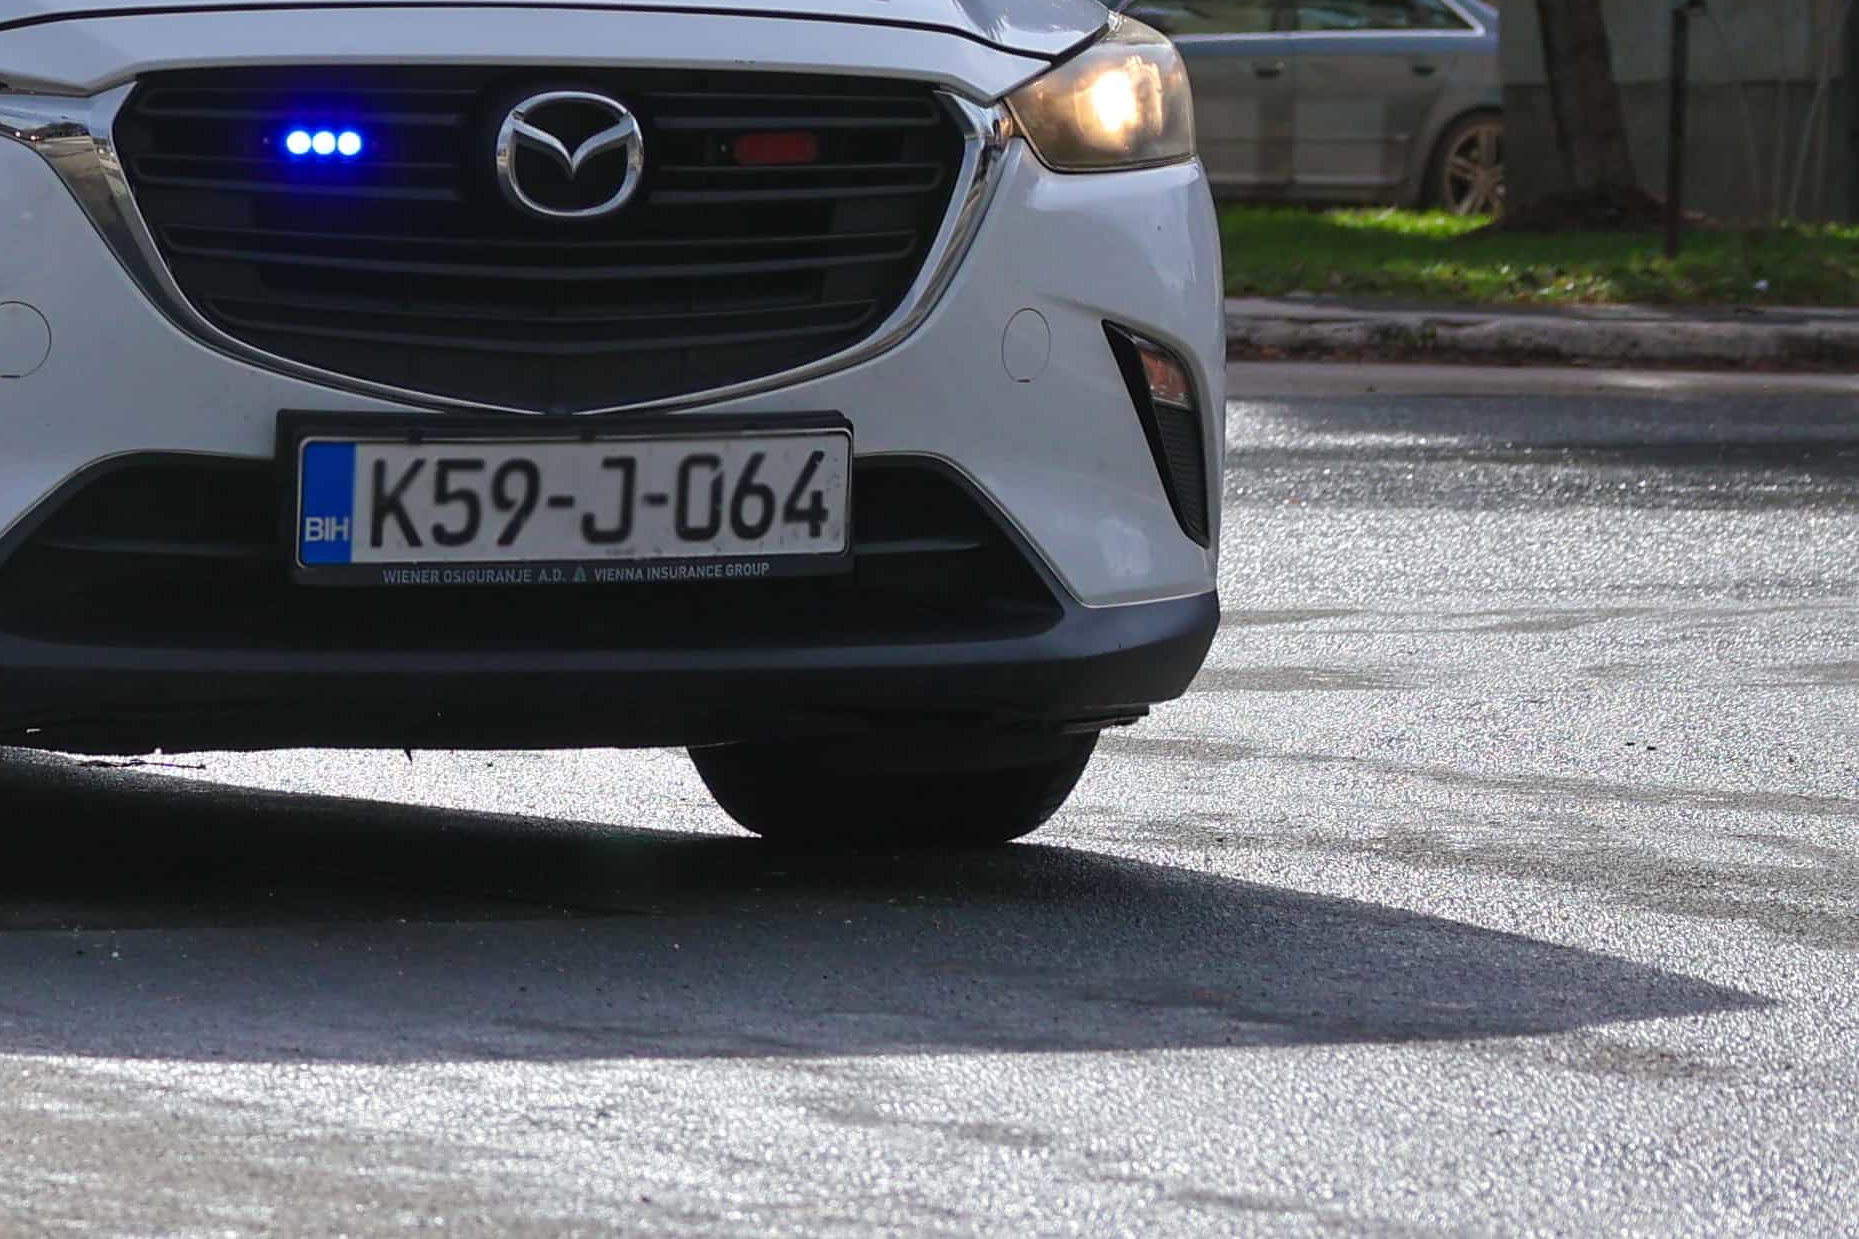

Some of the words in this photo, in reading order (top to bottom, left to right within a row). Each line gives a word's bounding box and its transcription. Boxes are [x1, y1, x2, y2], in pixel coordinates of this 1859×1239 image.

[369, 450, 829, 549] K59-J-064
[303, 516, 350, 542] BIH
[383, 569, 440, 585] WIENER
[443, 568, 532, 584] OSIGURANJE
[537, 567, 567, 583] A.D.
[594, 566, 644, 583] VIENNA
[647, 563, 722, 581] INSURANCE
[725, 561, 771, 577] GROUP
